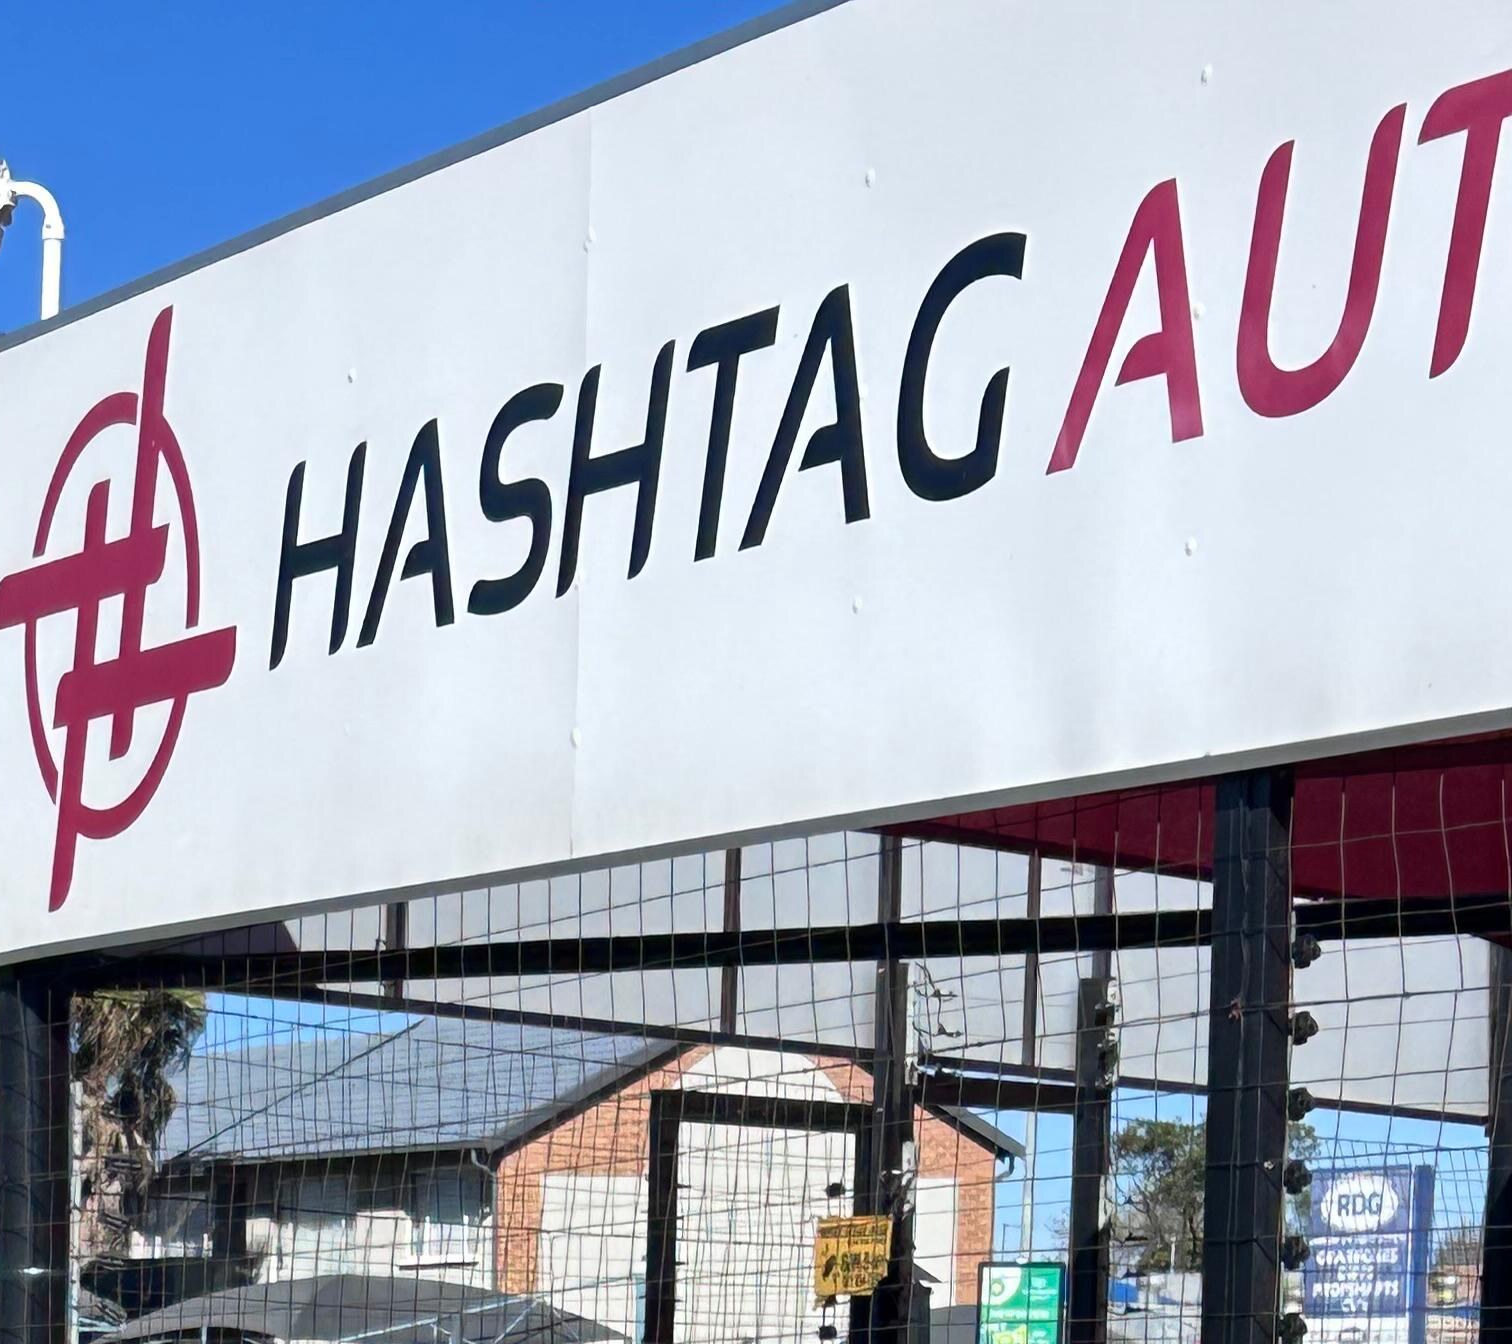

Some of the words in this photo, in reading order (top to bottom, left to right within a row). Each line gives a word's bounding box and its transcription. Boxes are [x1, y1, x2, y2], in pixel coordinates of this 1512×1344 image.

[269, 232, 1027, 671] HASHTAG
[1044, 68, 1512, 476] AUT
[1338, 1193, 1382, 1217] RDG
